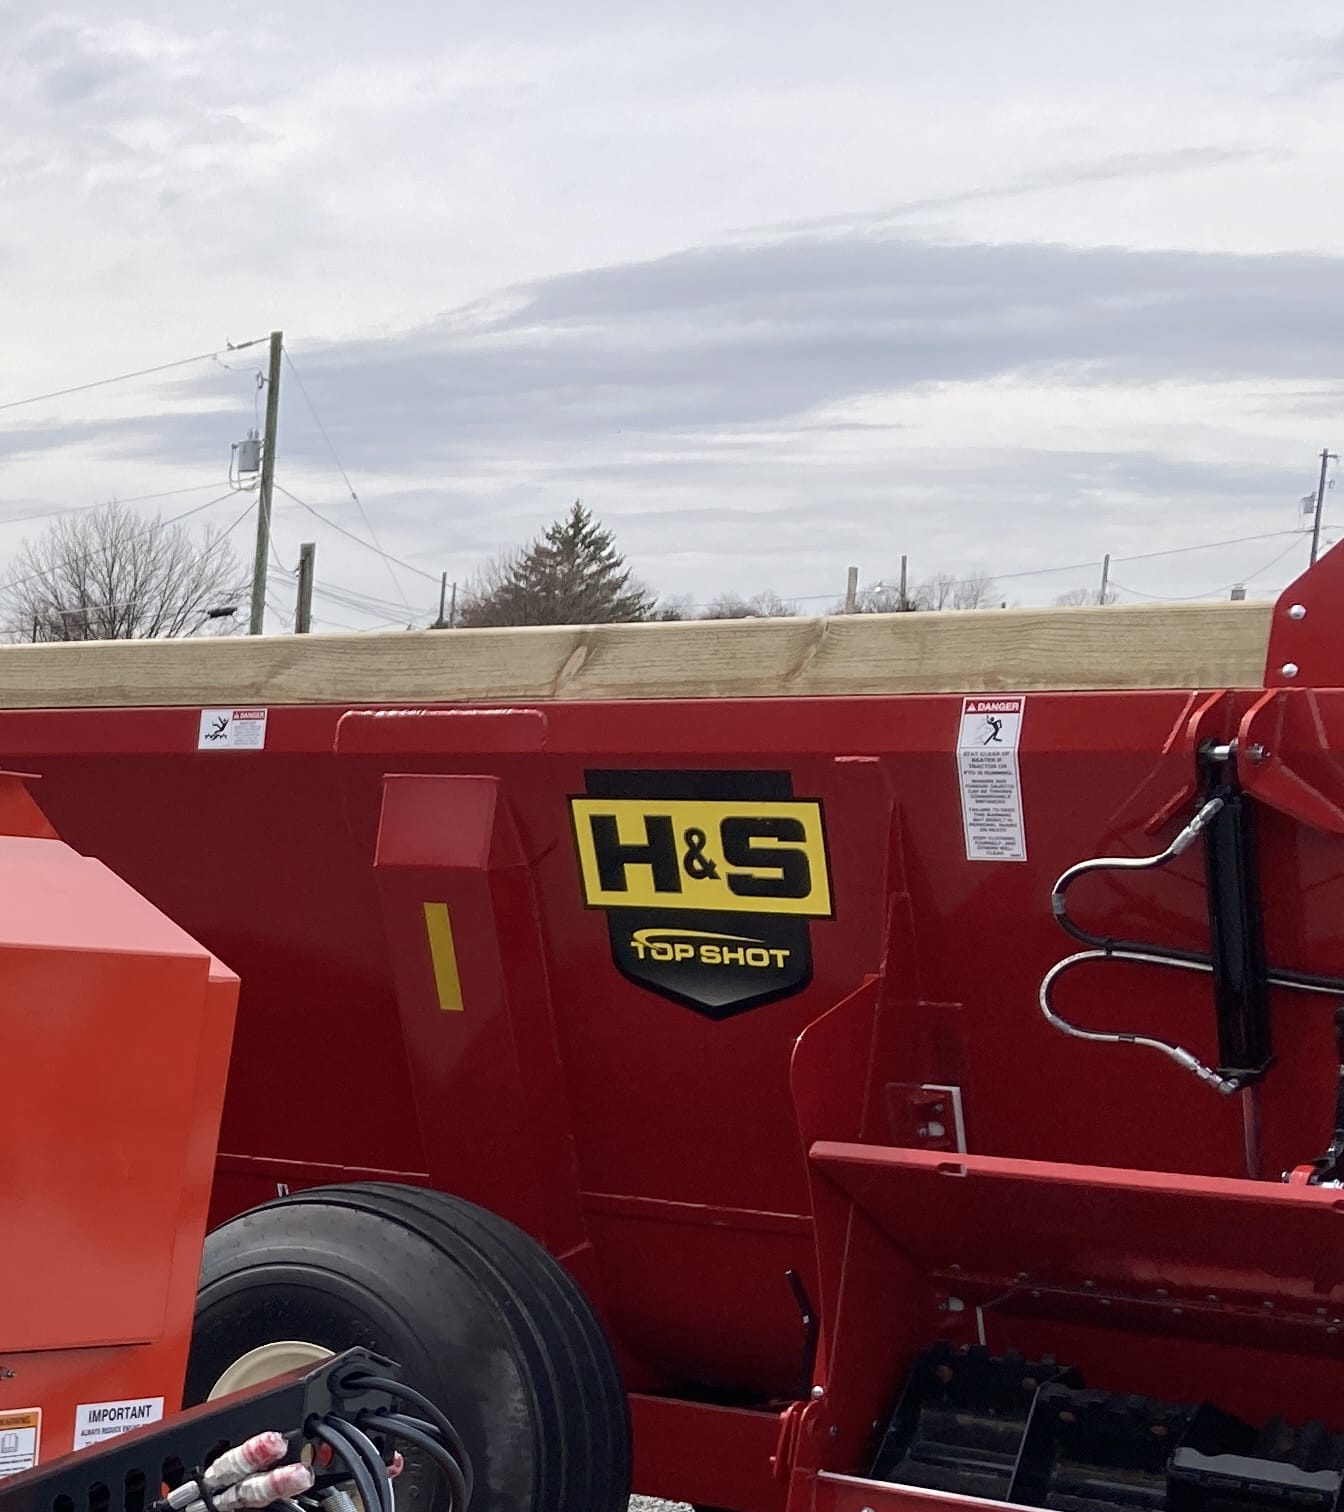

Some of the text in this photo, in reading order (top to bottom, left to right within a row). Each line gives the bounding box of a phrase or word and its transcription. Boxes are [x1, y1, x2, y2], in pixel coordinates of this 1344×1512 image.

[239, 711, 265, 720] DANGER
[977, 701, 1020, 712] DANGER
[588, 813, 813, 900] H&S
[630, 940, 791, 969] TOP SHOT
[88, 1404, 153, 1423] IMPORTANT
